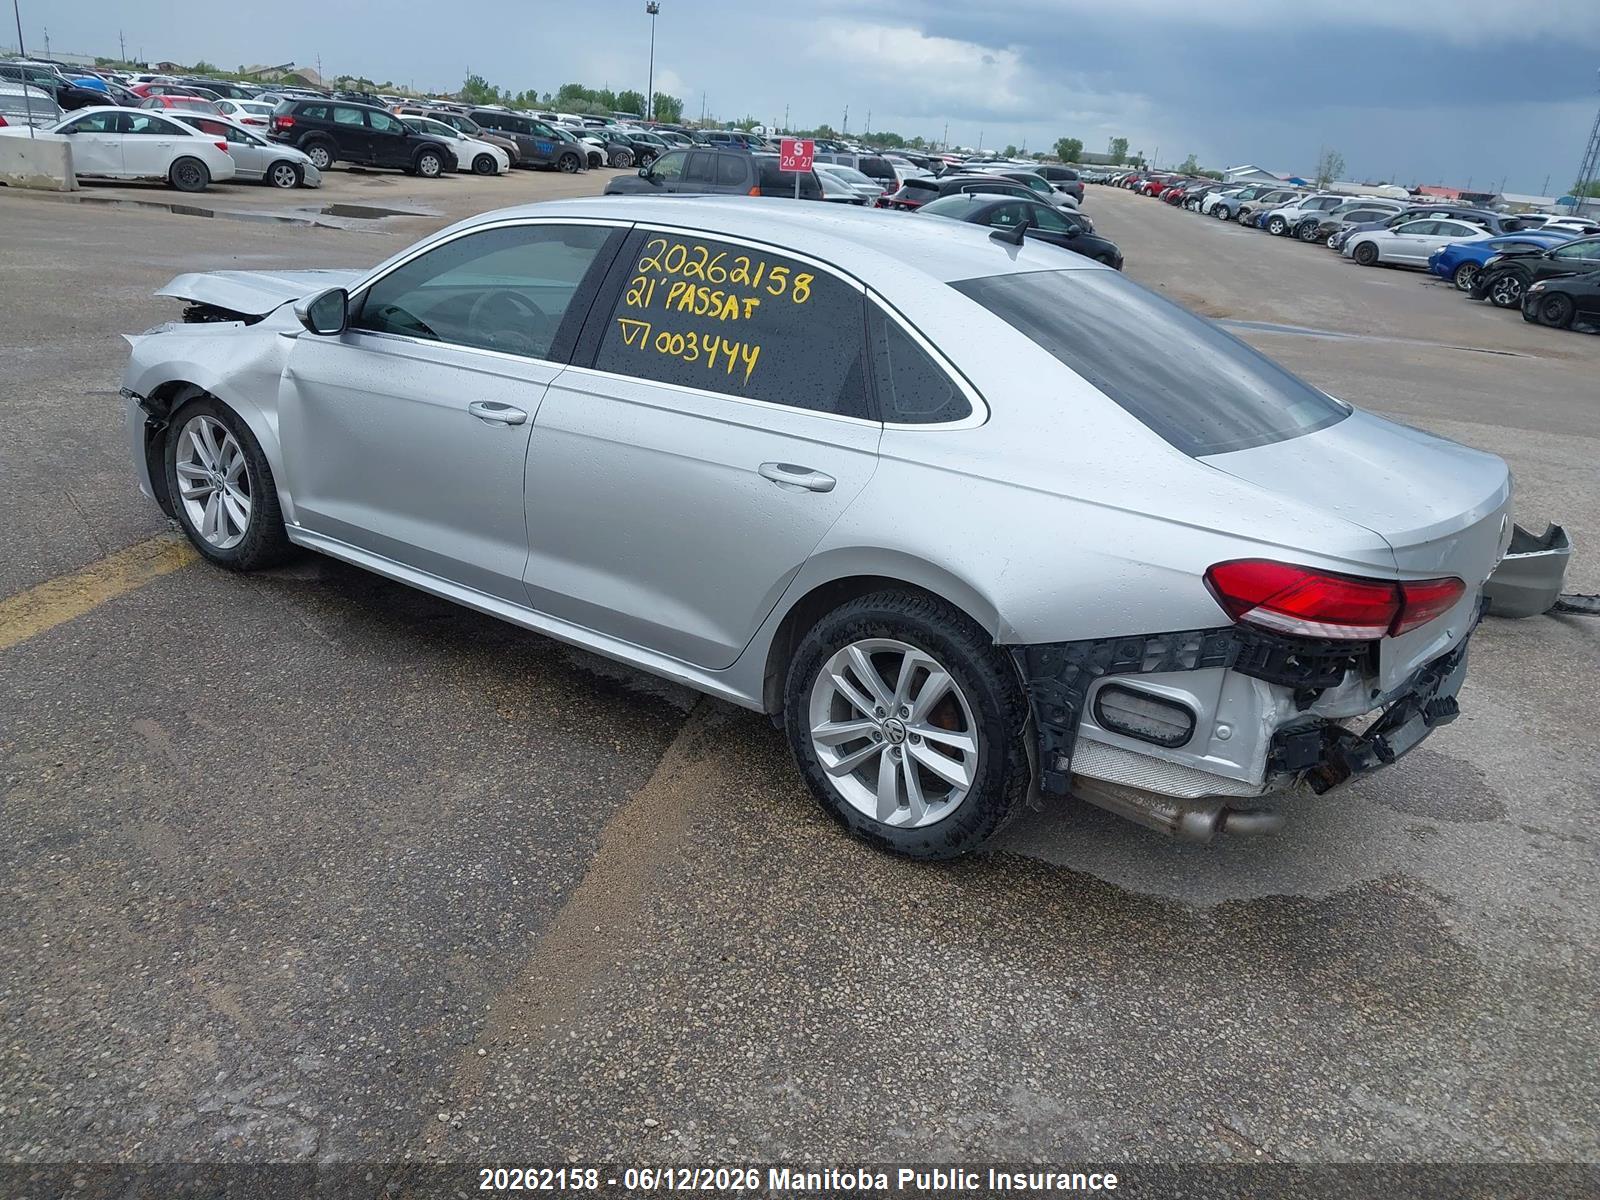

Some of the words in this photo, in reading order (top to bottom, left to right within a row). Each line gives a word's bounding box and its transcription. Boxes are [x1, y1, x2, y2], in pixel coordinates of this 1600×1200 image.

[782, 155, 796, 167] 26
[801, 156, 812, 168] 27
[793, 142, 804, 156] S
[638, 239, 815, 304] 20262158
[666, 281, 761, 320] PASSAT
